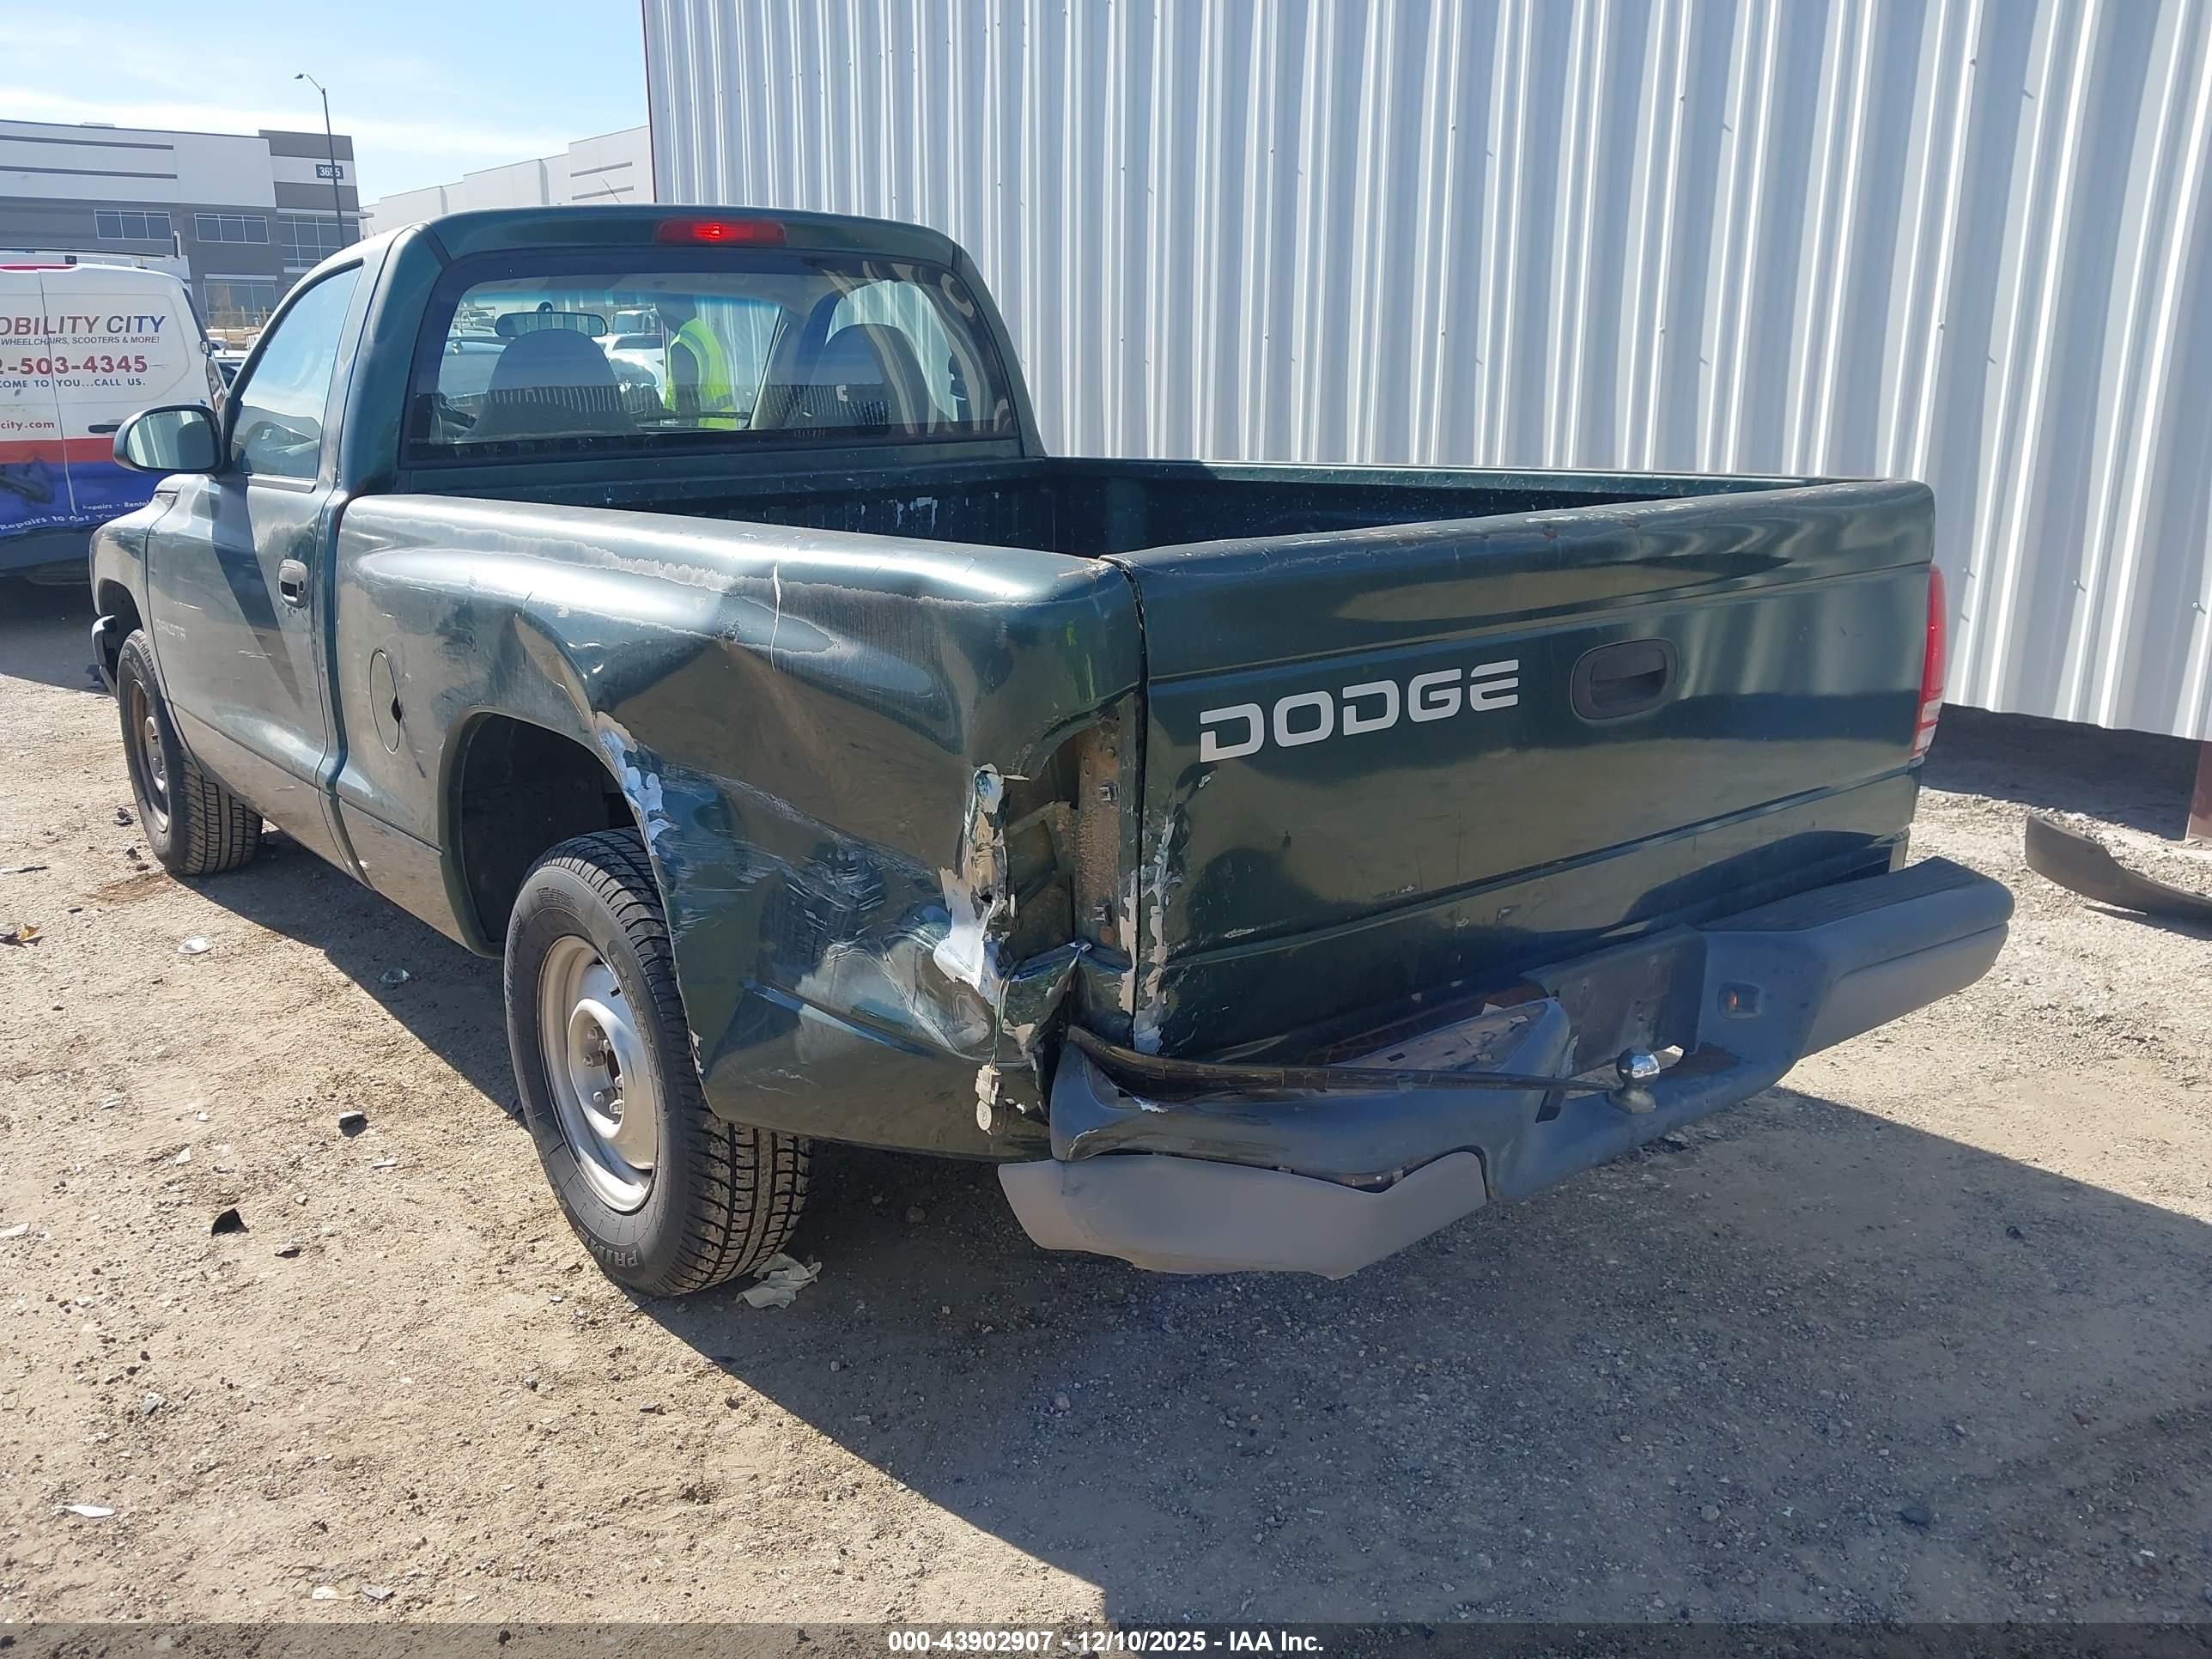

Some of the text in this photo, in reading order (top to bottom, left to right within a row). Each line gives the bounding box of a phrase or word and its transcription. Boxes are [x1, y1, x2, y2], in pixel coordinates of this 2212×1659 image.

[106, 315, 166, 333] CITY
[1, 337, 70, 346] WHEELCHAIRS,
[71, 336, 120, 344] SCOOTERS
[1200, 659, 1519, 763] DODGE
